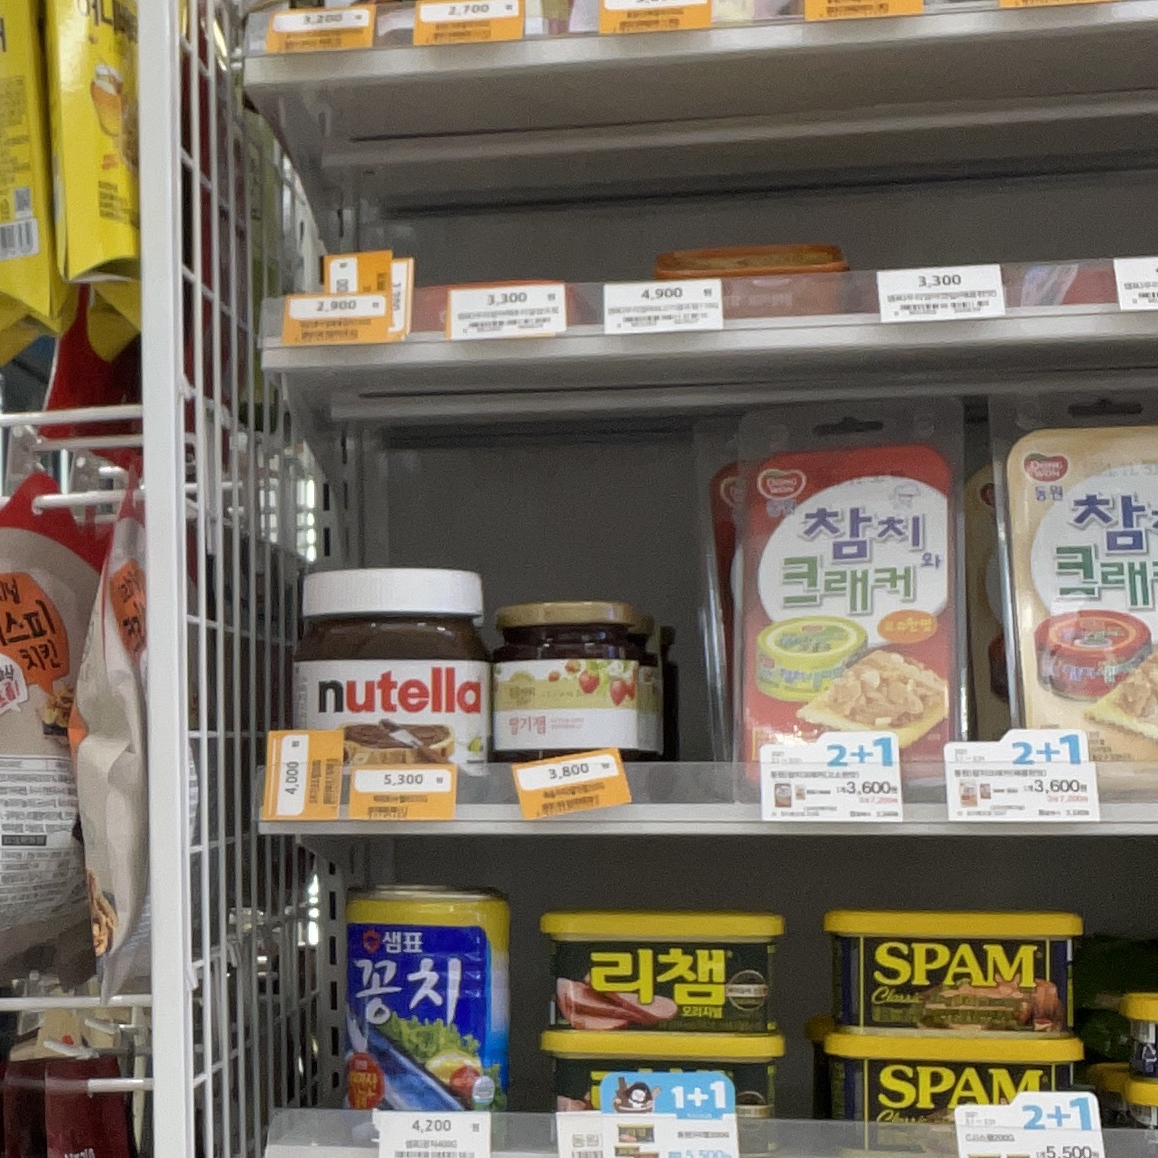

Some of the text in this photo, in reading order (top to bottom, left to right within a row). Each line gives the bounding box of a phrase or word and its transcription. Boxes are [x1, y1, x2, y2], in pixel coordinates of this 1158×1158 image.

[803, 506, 925, 560] 참치
[1071, 494, 1158, 552] 참
[921, 552, 941, 569] 와
[1056, 544, 1158, 608] 크래
[782, 555, 917, 614] 크래커
[20, 639, 61, 671] 치킨
[318, 667, 481, 714] nutella
[826, 736, 894, 767] 2+1
[1012, 734, 1081, 765] 2+1
[286, 761, 299, 795] 4,000
[384, 773, 424, 788] 5,300
[548, 763, 589, 781] 3,800
[382, 931, 424, 953] 샘표
[590, 947, 726, 1006] 리챔
[873, 941, 1038, 988] SPAM
[353, 958, 462, 1026] 꽁치
[671, 1080, 727, 1110] 1+1
[877, 1064, 1044, 1110] SPAM
[411, 1119, 452, 1134] 4,200
[1022, 1096, 1093, 1131] 2+1
